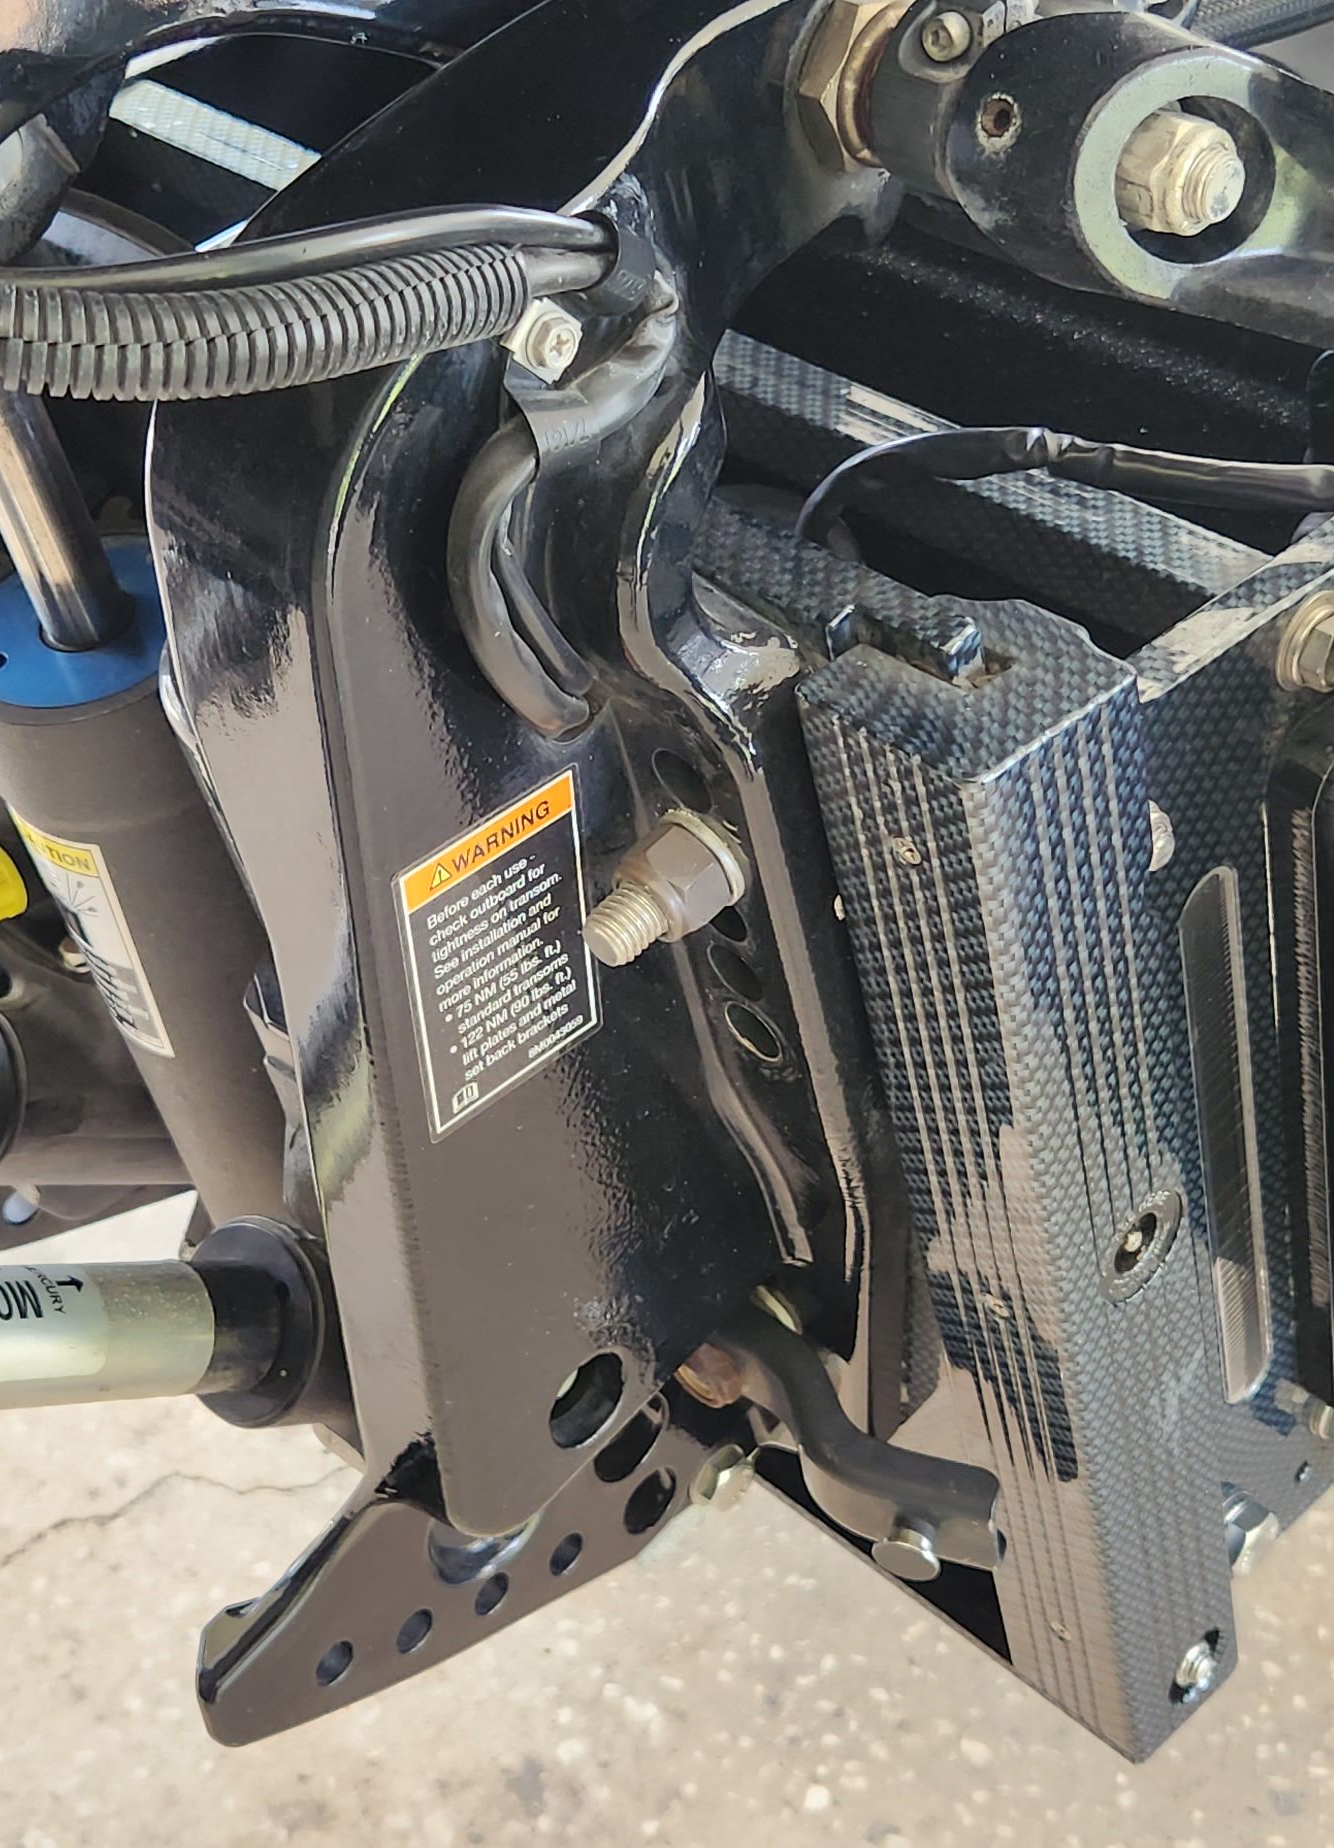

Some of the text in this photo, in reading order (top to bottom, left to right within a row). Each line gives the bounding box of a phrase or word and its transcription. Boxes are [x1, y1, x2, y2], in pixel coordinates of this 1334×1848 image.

[451, 801, 550, 872] WARNING
[427, 896, 469, 930] Before
[471, 874, 502, 899] each
[504, 860, 528, 879] use
[429, 864, 547, 946] check outboard for
[431, 873, 563, 963] tightness on transom.
[434, 892, 552, 979] See installation and
[436, 906, 561, 996] operation manual for
[438, 937, 544, 1013] more information.
[455, 939, 562, 1019] 75 NM (55 lbs. ft.)
[457, 953, 569, 1035] standard transoms
[460, 966, 573, 1049] 122 NM (90 lbs. ft.)
[462, 979, 577, 1067] lift plates and metal
[465, 1003, 569, 1081] set back brackets
